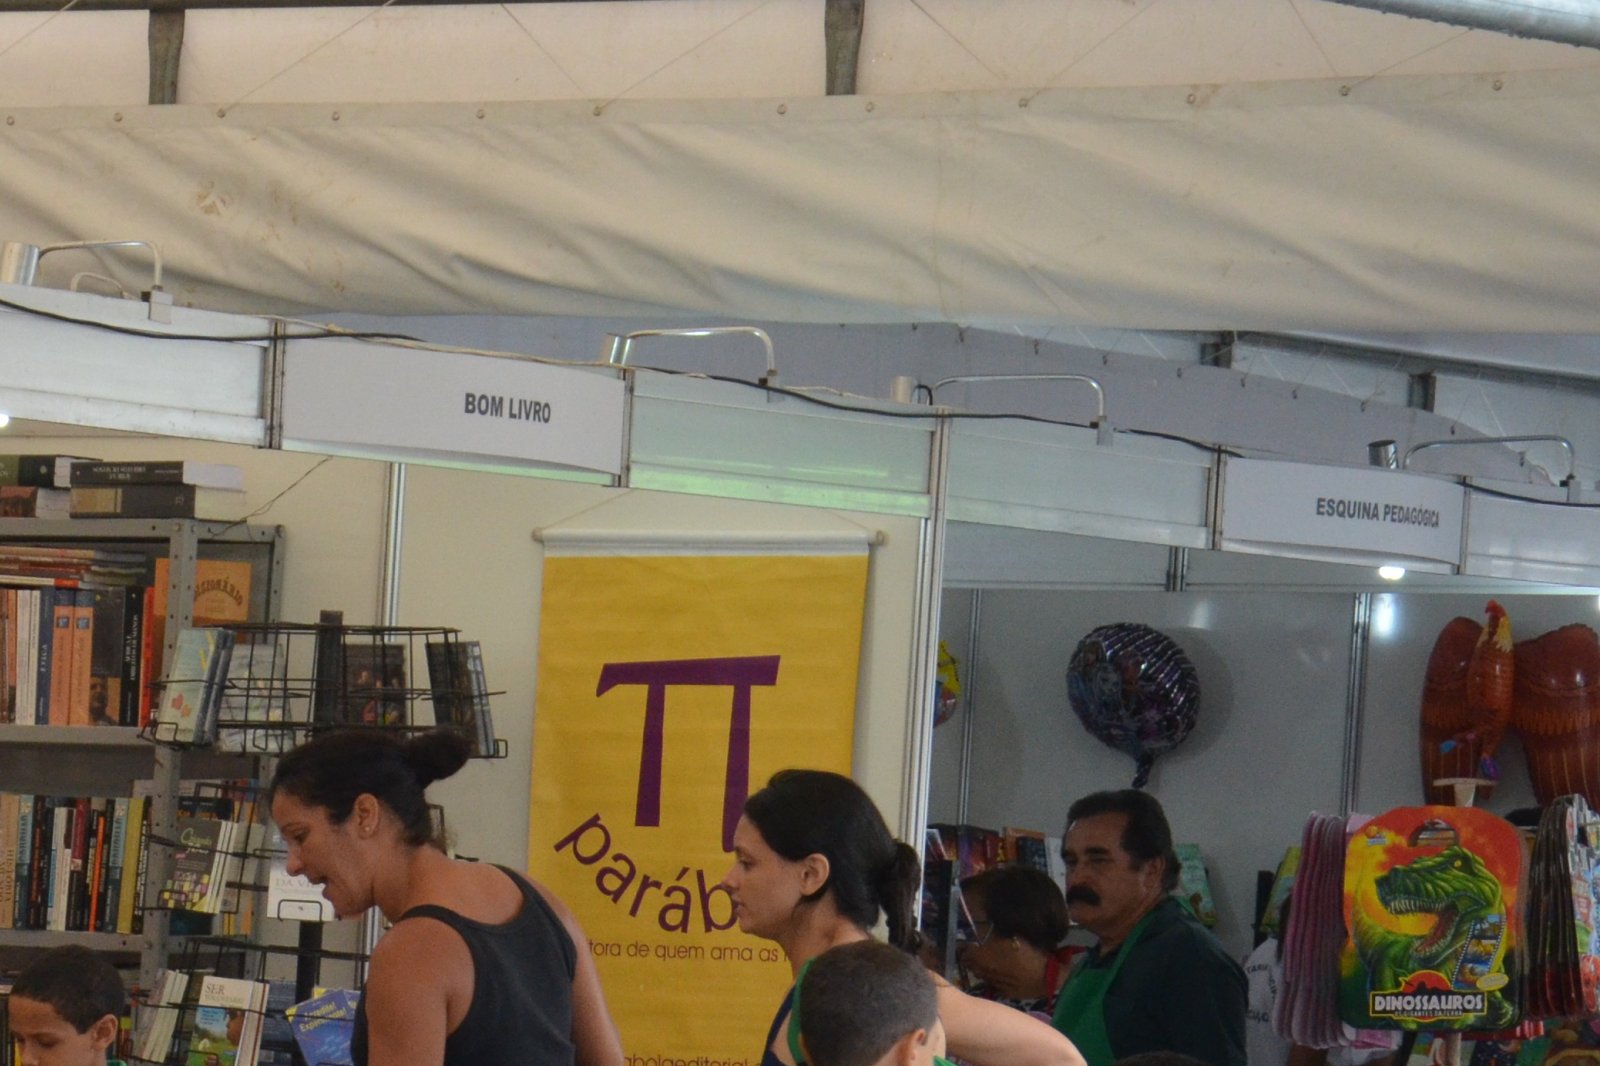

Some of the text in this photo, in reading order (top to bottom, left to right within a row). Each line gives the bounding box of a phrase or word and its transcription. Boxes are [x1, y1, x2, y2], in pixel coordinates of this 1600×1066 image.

[463, 393, 552, 423] BOM LIVRO
[1315, 497, 1440, 529] ESQUINA PEDAGÓGICA
[626, 941, 649, 957] de
[654, 943, 705, 962] quem
[710, 948, 753, 962] ama
[758, 949, 779, 963] as
[1374, 994, 1483, 1012] DINOSSAUROS
